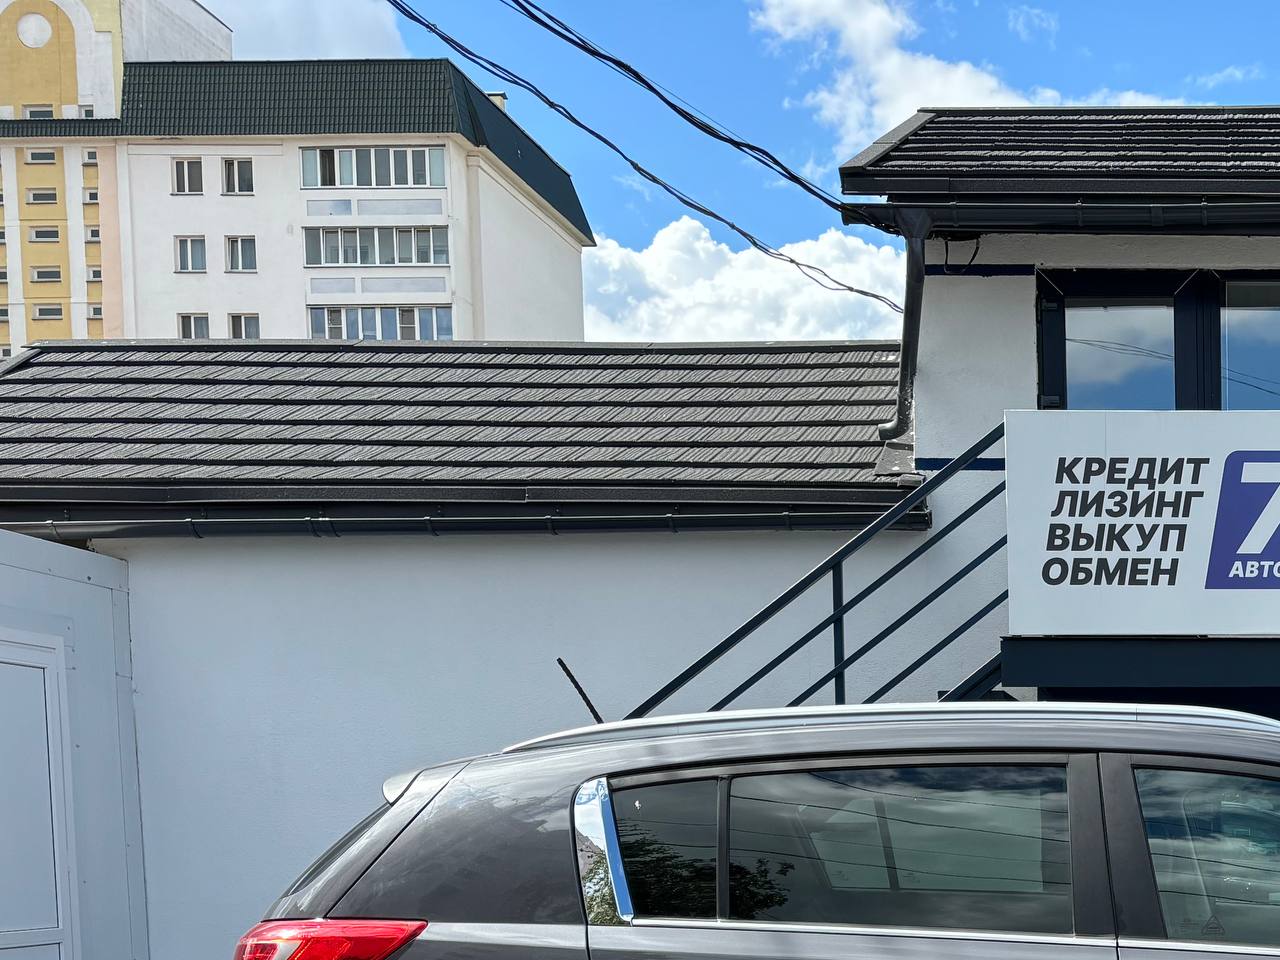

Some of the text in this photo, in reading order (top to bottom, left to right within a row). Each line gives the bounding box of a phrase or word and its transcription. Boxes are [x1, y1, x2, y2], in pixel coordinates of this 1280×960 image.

[1054, 456, 1211, 489] КРЕДИТ
[1050, 490, 1205, 518] ЛИЗИНГ
[1045, 523, 1188, 553] ВЫКУП
[1041, 557, 1180, 587] ОБМЕН
